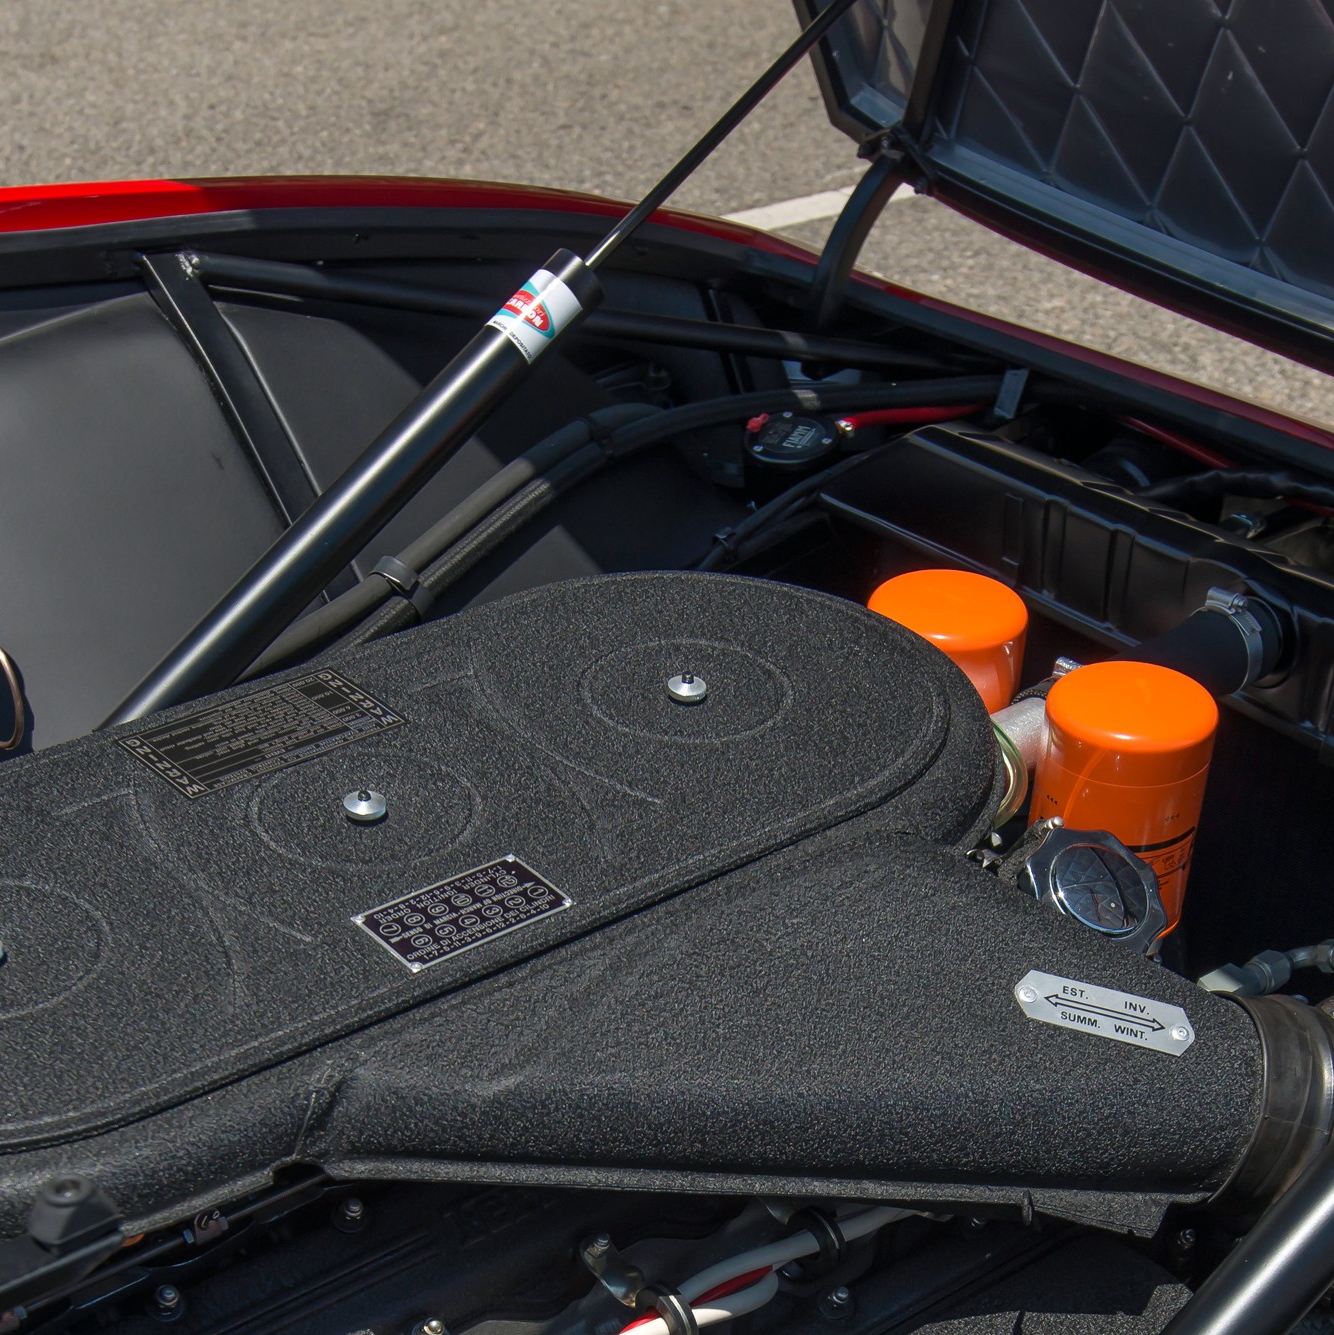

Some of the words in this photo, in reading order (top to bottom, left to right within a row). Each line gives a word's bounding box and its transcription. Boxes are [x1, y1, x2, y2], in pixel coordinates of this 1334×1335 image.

[782, 425, 811, 448] FIAMM
[315, 670, 400, 725] WARNING
[122, 736, 205, 794] WARNING
[461, 868, 507, 890] CYLINDER
[415, 888, 458, 908] IGNITION
[377, 907, 412, 924] ORDER
[405, 942, 441, 960] ORDINE
[439, 938, 452, 946] DI
[449, 915, 505, 941] ACCENSIONE
[504, 909, 520, 918] DEI
[518, 894, 556, 912] CILINDRI
[1062, 985, 1089, 1000] EST.
[1124, 1001, 1150, 1015] INV.
[1061, 1011, 1101, 1029] SUMM.
[1114, 1024, 1148, 1041] WINT.
